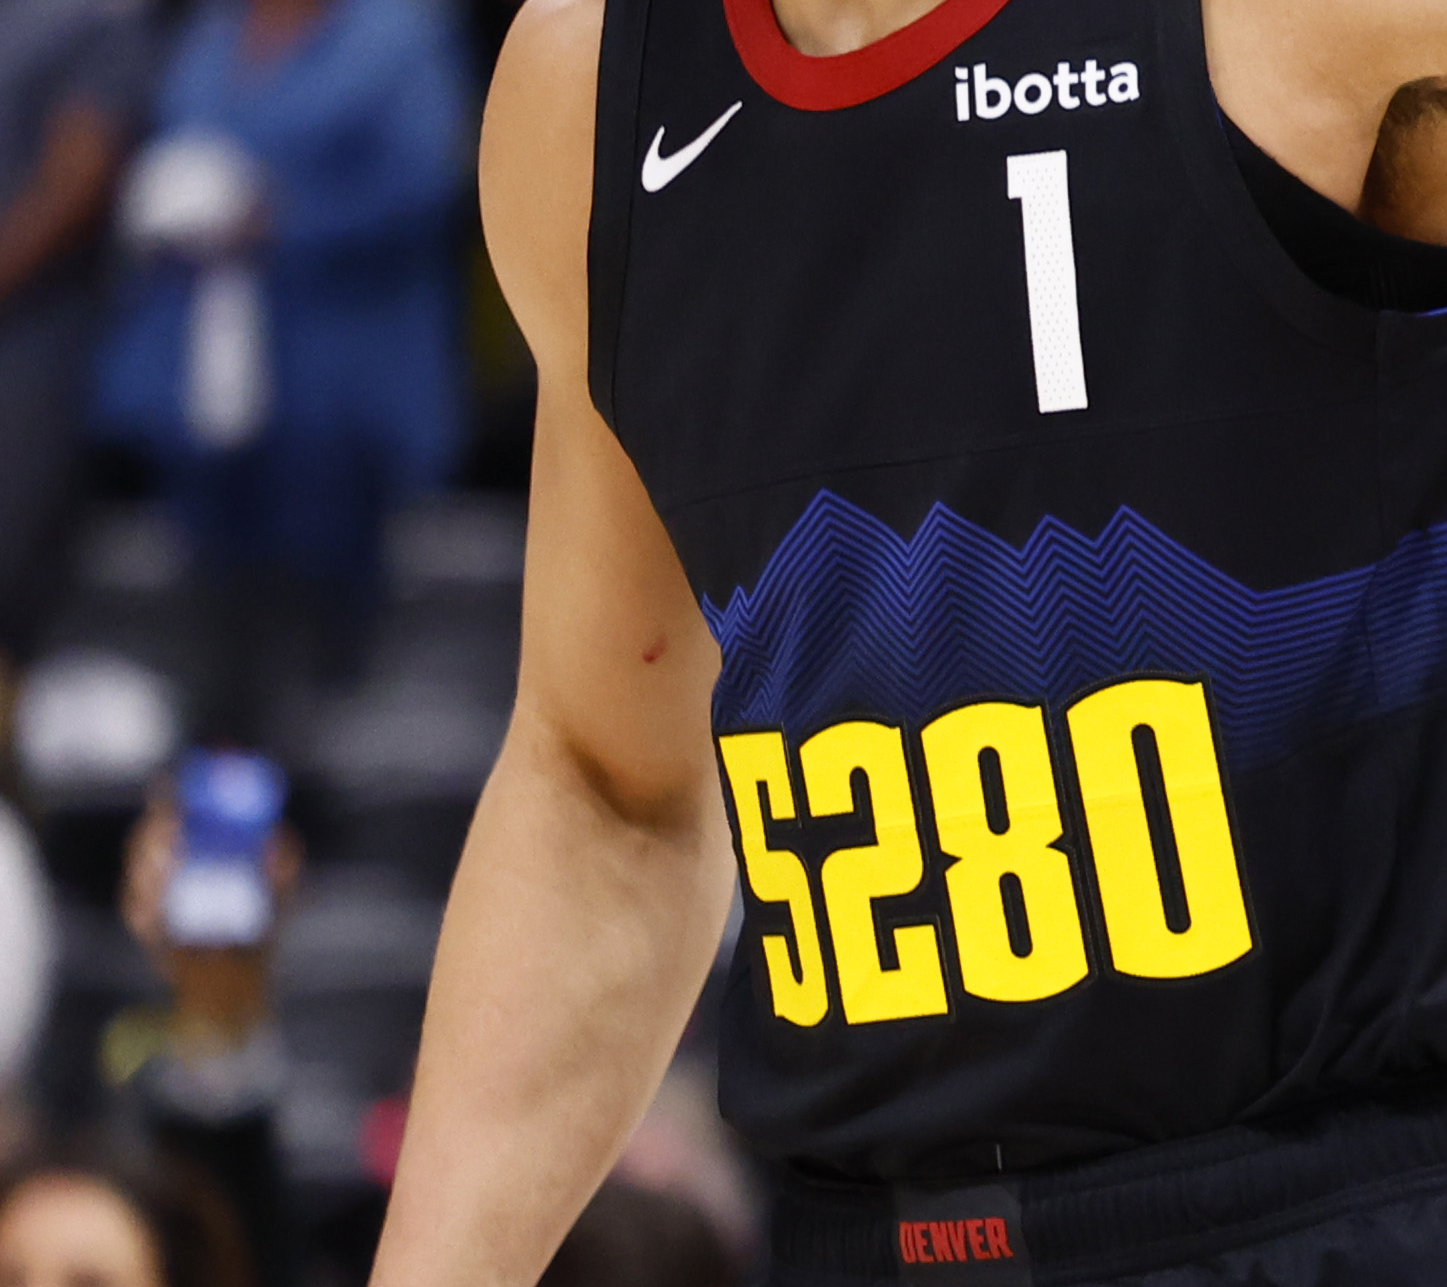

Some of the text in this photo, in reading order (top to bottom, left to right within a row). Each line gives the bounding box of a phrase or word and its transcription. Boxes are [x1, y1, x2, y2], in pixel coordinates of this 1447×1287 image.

[954, 59, 1141, 121] ibotta
[1006, 149, 1089, 414] 1
[718, 678, 1254, 1027] 5280
[899, 1217, 1015, 1263] DENVER
